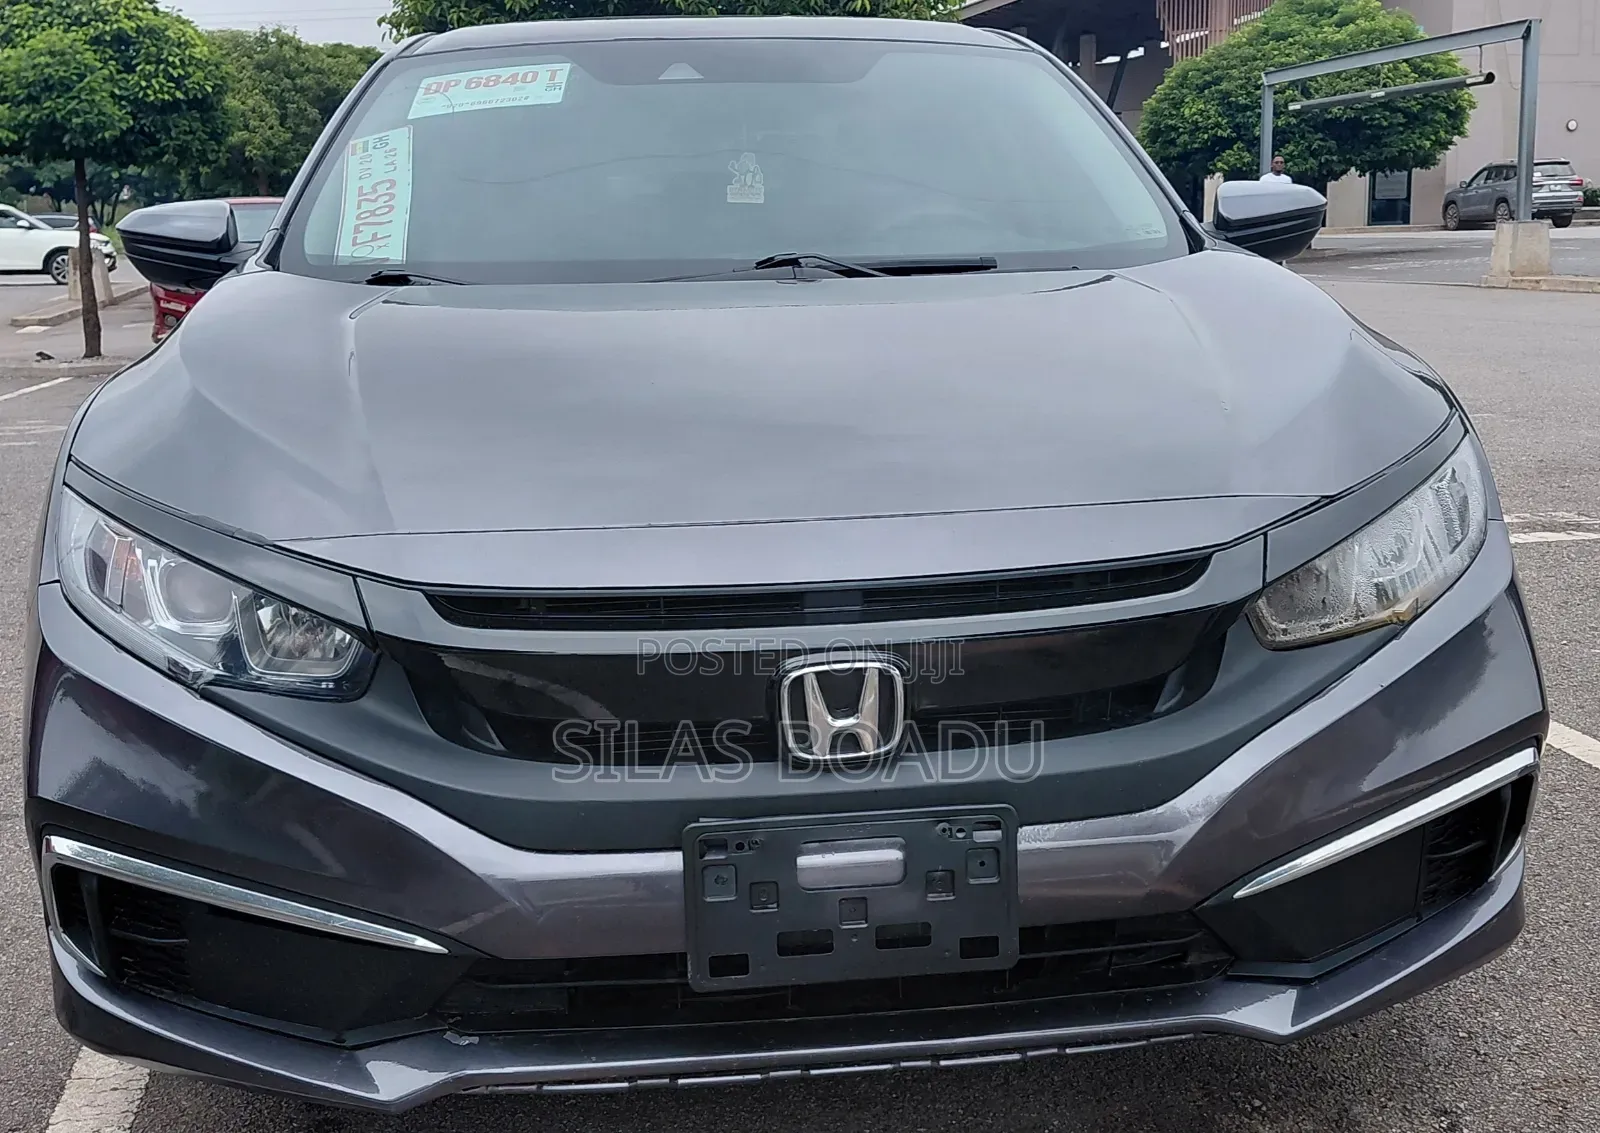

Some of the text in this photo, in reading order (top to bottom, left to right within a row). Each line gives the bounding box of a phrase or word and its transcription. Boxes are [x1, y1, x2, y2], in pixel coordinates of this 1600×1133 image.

[464, 70, 539, 90] 6840
[545, 68, 564, 82] T
[372, 134, 390, 150] GH
